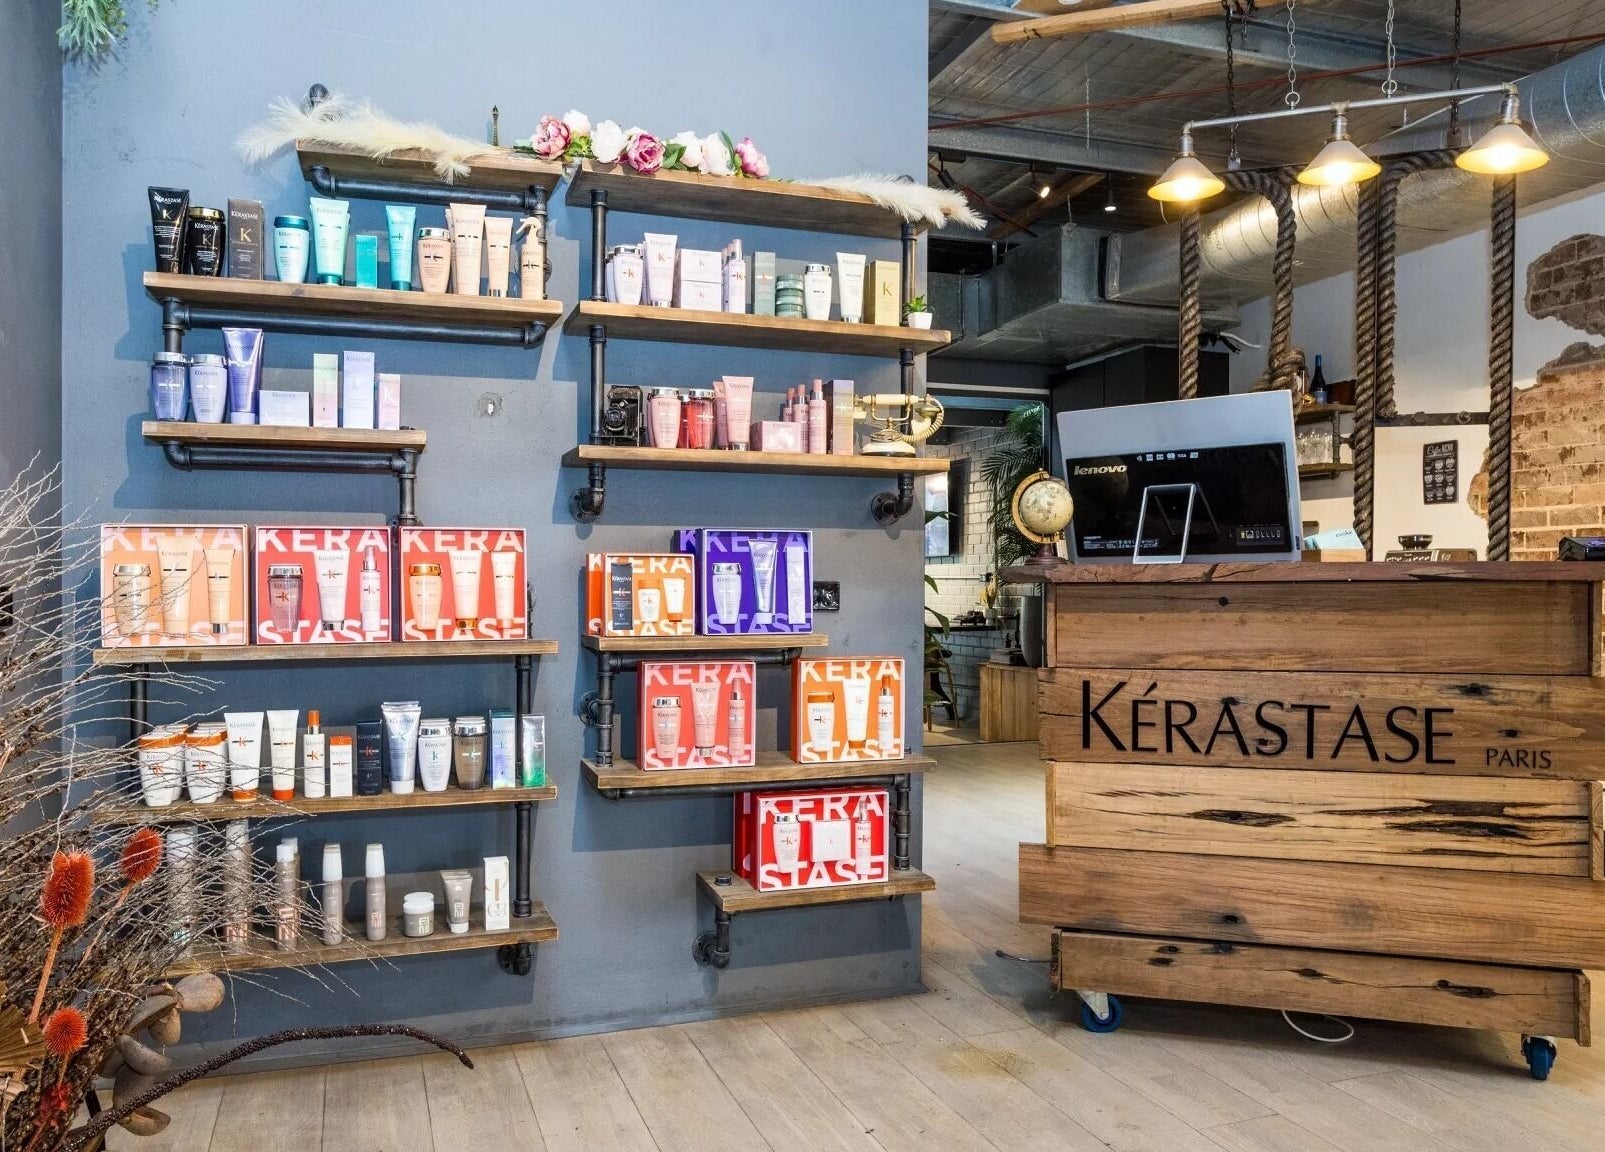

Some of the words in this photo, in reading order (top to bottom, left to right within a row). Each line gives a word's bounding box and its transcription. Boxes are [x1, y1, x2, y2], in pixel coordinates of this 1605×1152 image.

[1073, 465, 1128, 476] lenovo
[258, 529, 388, 553] KERA
[402, 530, 524, 553] KERA
[646, 664, 752, 686] KERA
[801, 661, 900, 683] KERA
[1082, 680, 1456, 764] KÉRASTASE
[1486, 748, 1552, 769] PARIS
[760, 795, 884, 825] KERA
